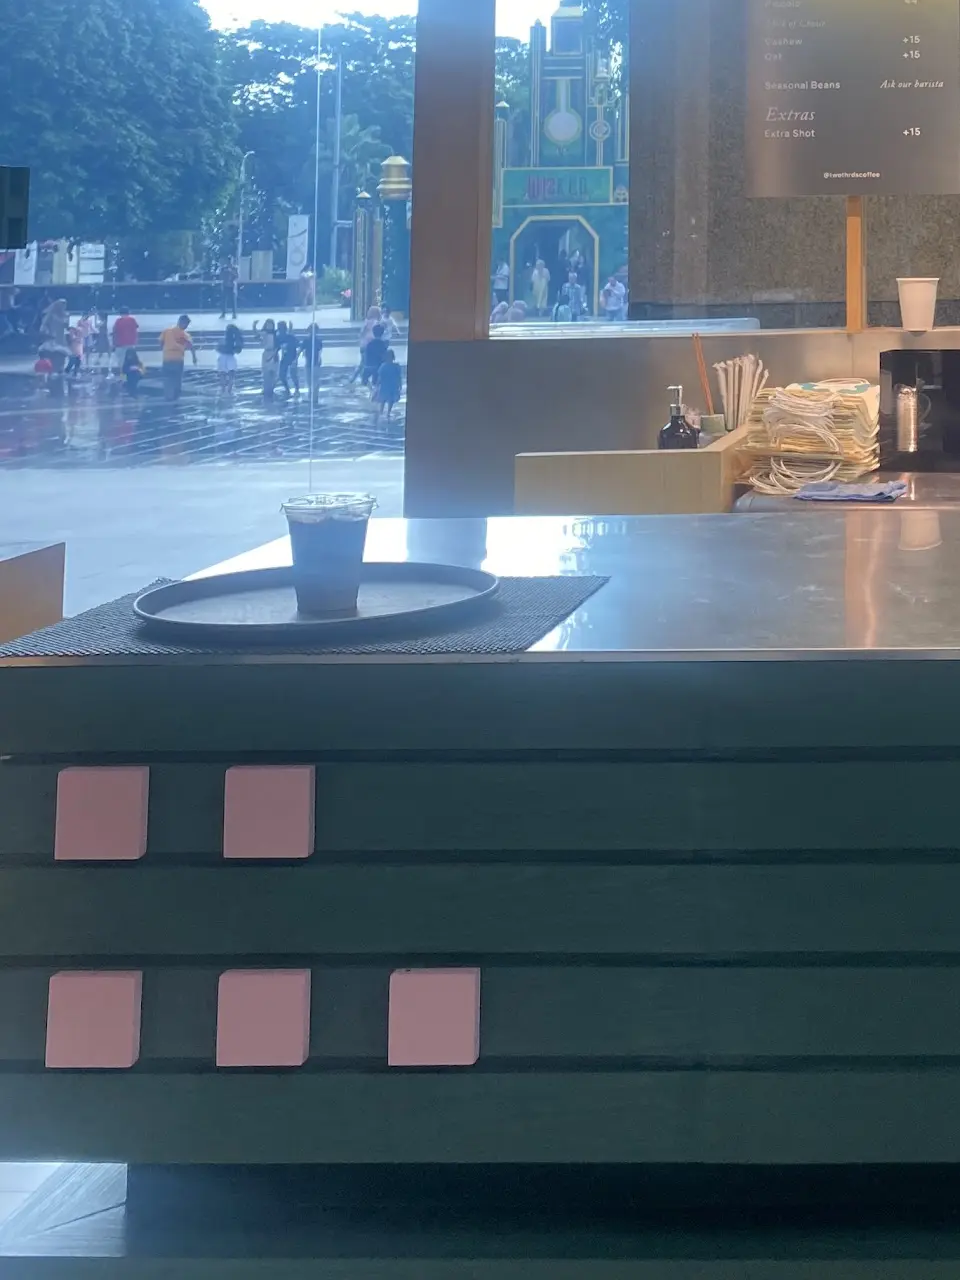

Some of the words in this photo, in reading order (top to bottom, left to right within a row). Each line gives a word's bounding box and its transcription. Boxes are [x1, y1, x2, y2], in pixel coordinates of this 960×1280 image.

[903, 36, 920, 44] +15
[765, 81, 808, 90] Seasonal
[811, 81, 840, 89] Beans
[880, 80, 895, 88] Ask
[914, 80, 943, 88] barista
[766, 107, 815, 121] Extras
[765, 130, 790, 138] Extra
[792, 129, 815, 137] Shot
[903, 128, 920, 136] +15
